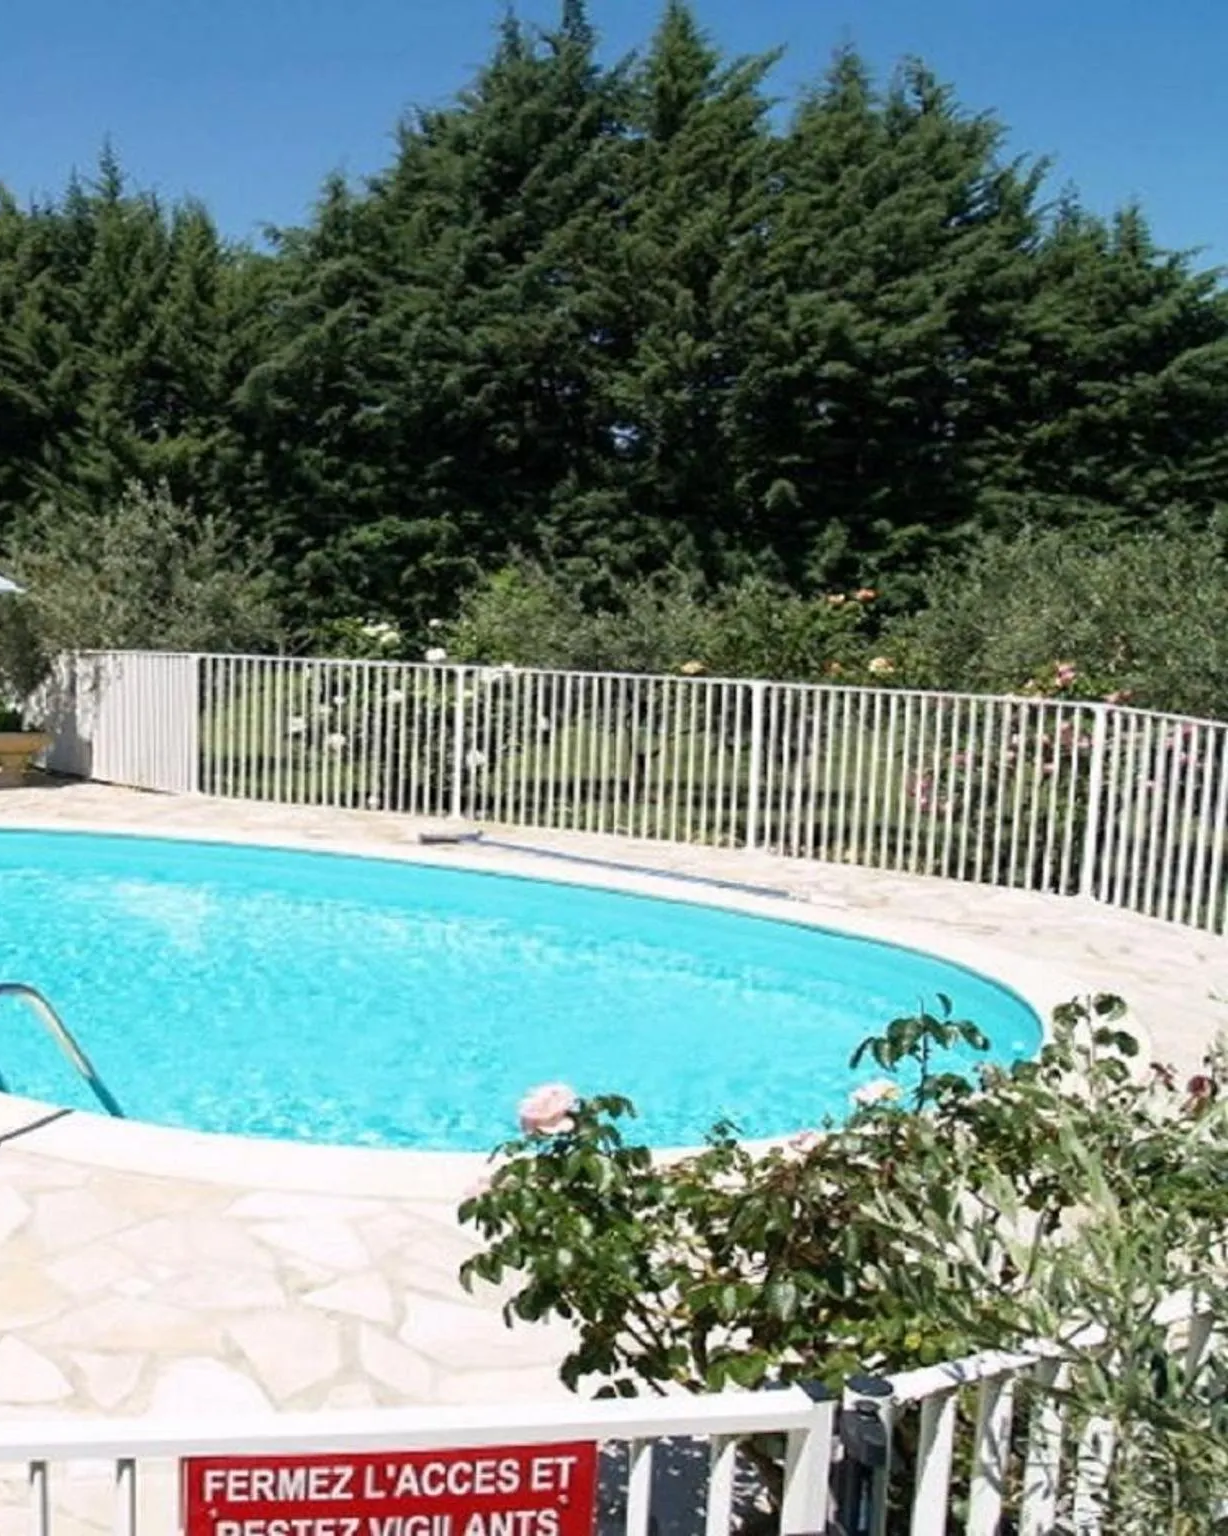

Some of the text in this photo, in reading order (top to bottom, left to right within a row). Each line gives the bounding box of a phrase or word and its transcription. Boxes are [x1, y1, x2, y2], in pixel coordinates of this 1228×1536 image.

[204, 1456, 577, 1502] FERMEZ L'ACCES ET
